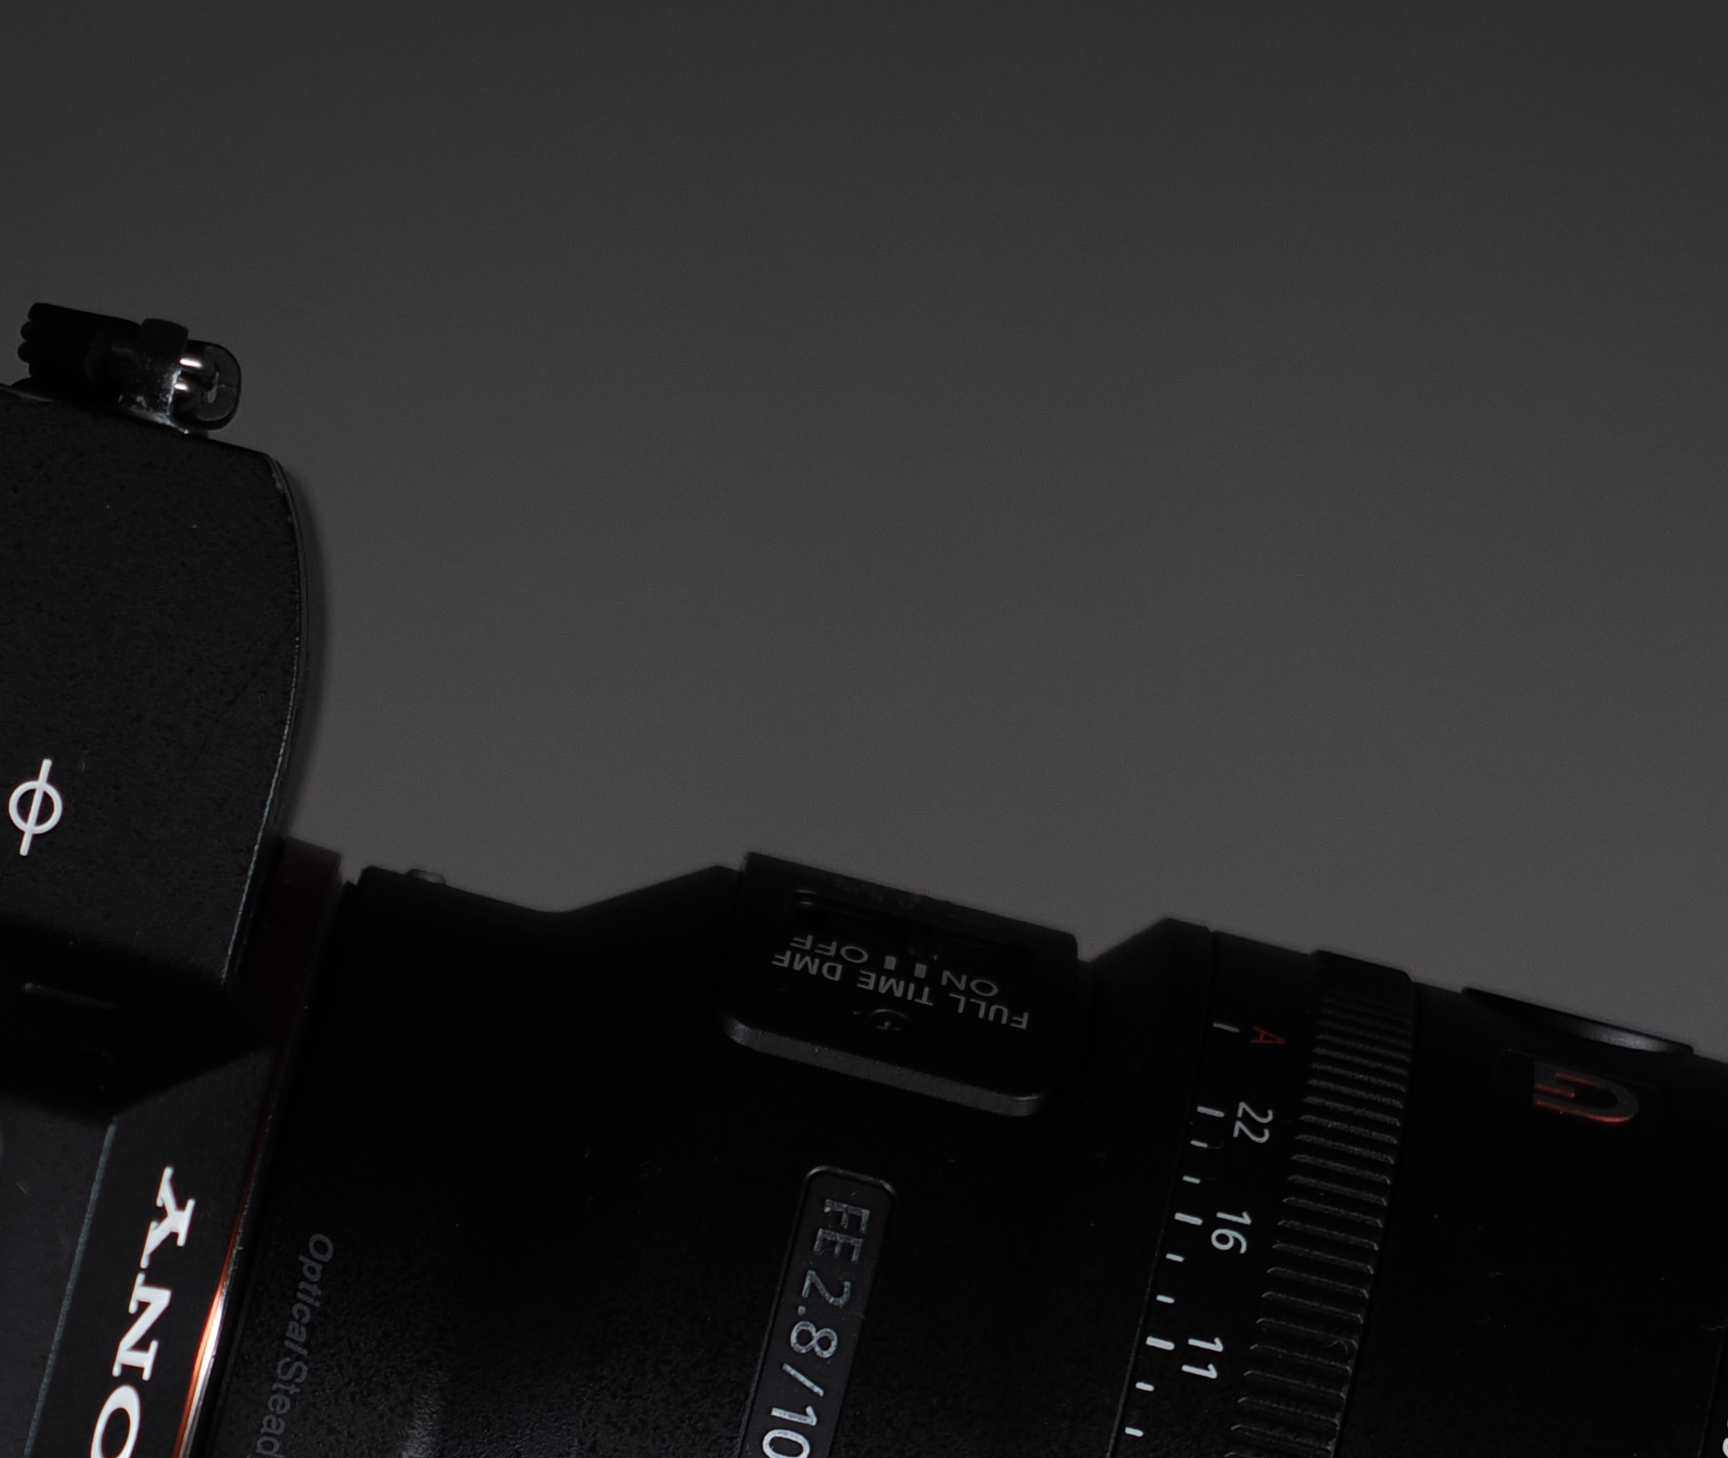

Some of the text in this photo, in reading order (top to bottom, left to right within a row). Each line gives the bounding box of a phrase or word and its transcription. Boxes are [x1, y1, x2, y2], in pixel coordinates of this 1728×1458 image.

[788, 933, 1000, 999] ON OFF
[770, 946, 1031, 1033] FULL TIME DMF
[1250, 1026, 1286, 1045] A
[1232, 1101, 1274, 1144] 22
[813, 1198, 871, 1262] FE
[1210, 1211, 1252, 1254] 16
[1181, 1337, 1224, 1379] 11
